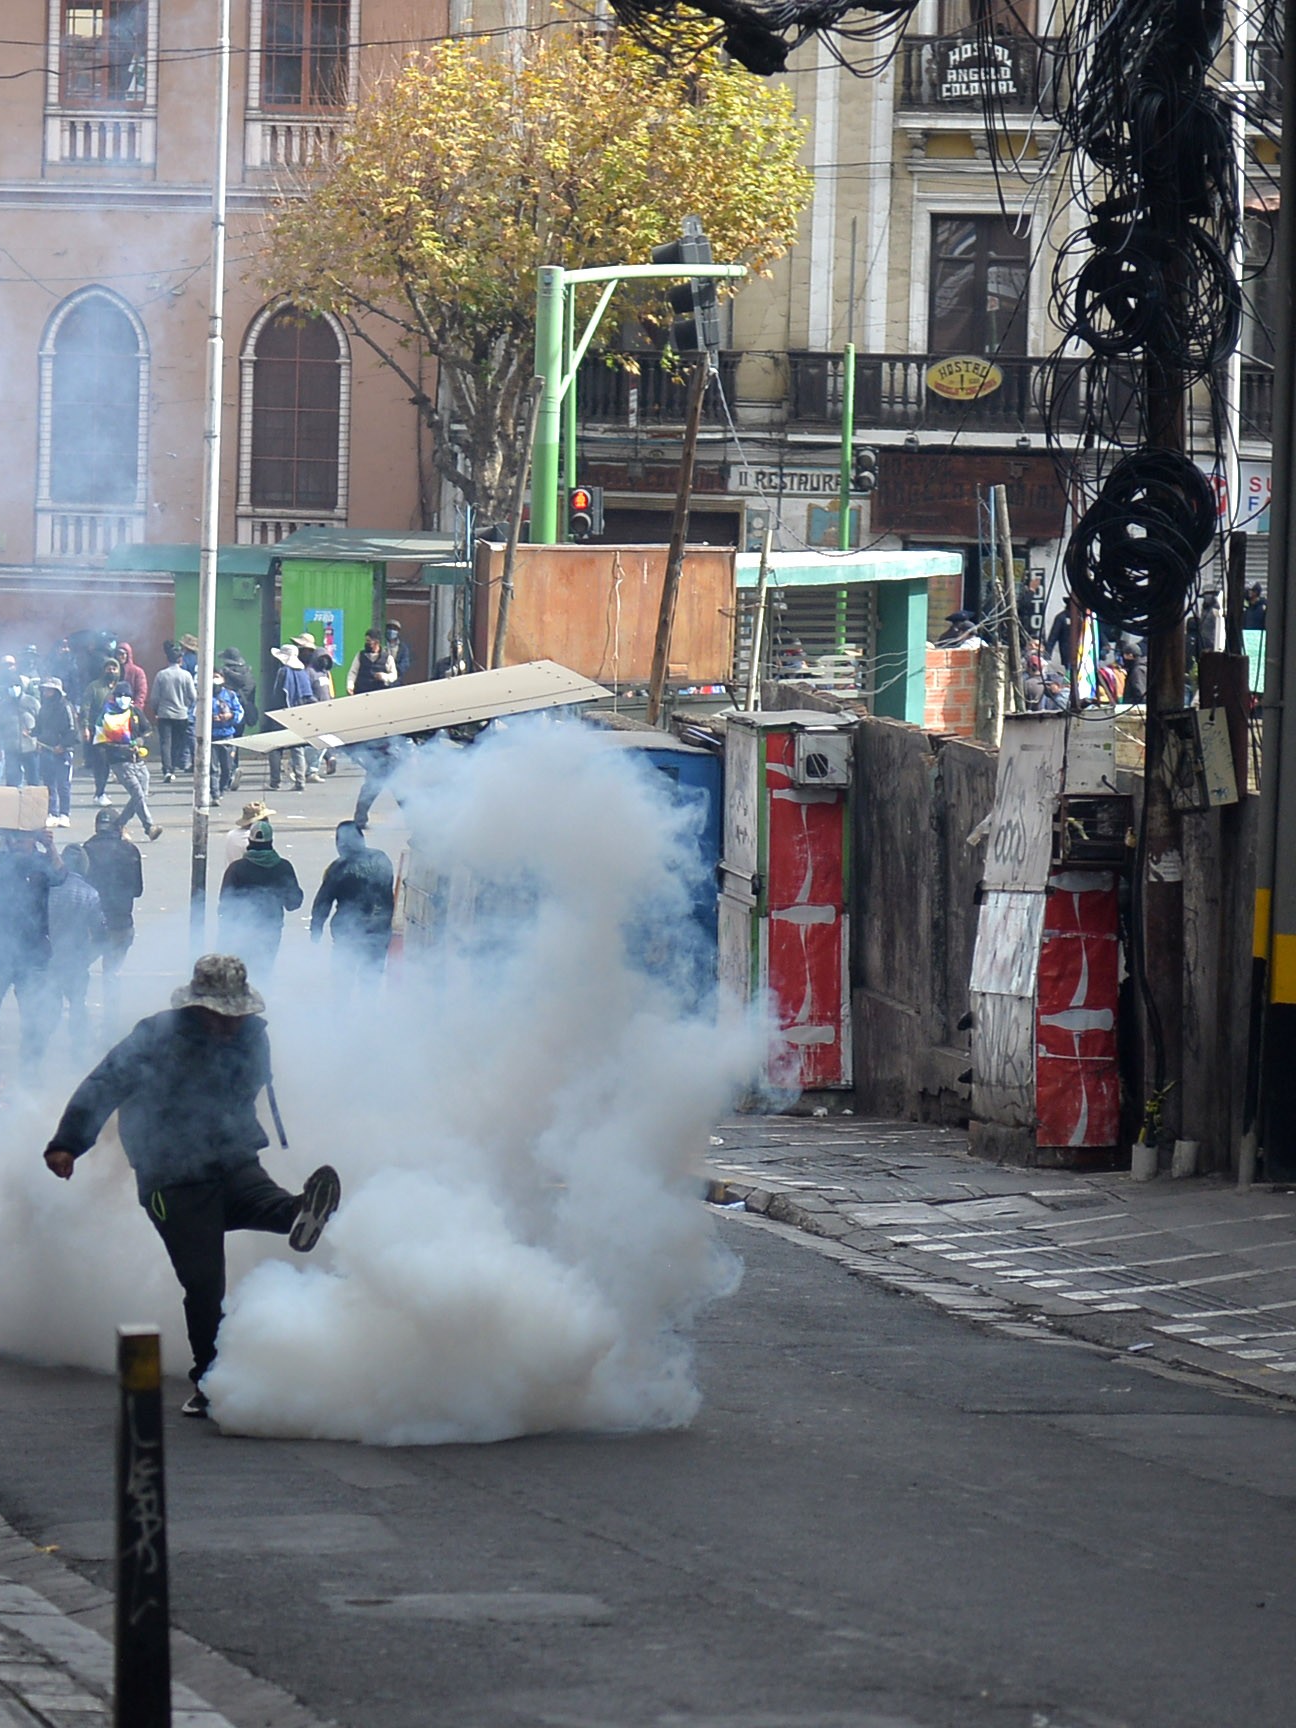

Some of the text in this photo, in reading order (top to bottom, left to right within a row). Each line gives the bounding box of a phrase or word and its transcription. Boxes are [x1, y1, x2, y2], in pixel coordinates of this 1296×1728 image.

[948, 43, 1013, 67] HOSTAL
[946, 67, 1011, 82] ANGELO
[942, 81, 1017, 97] COLONIAL
